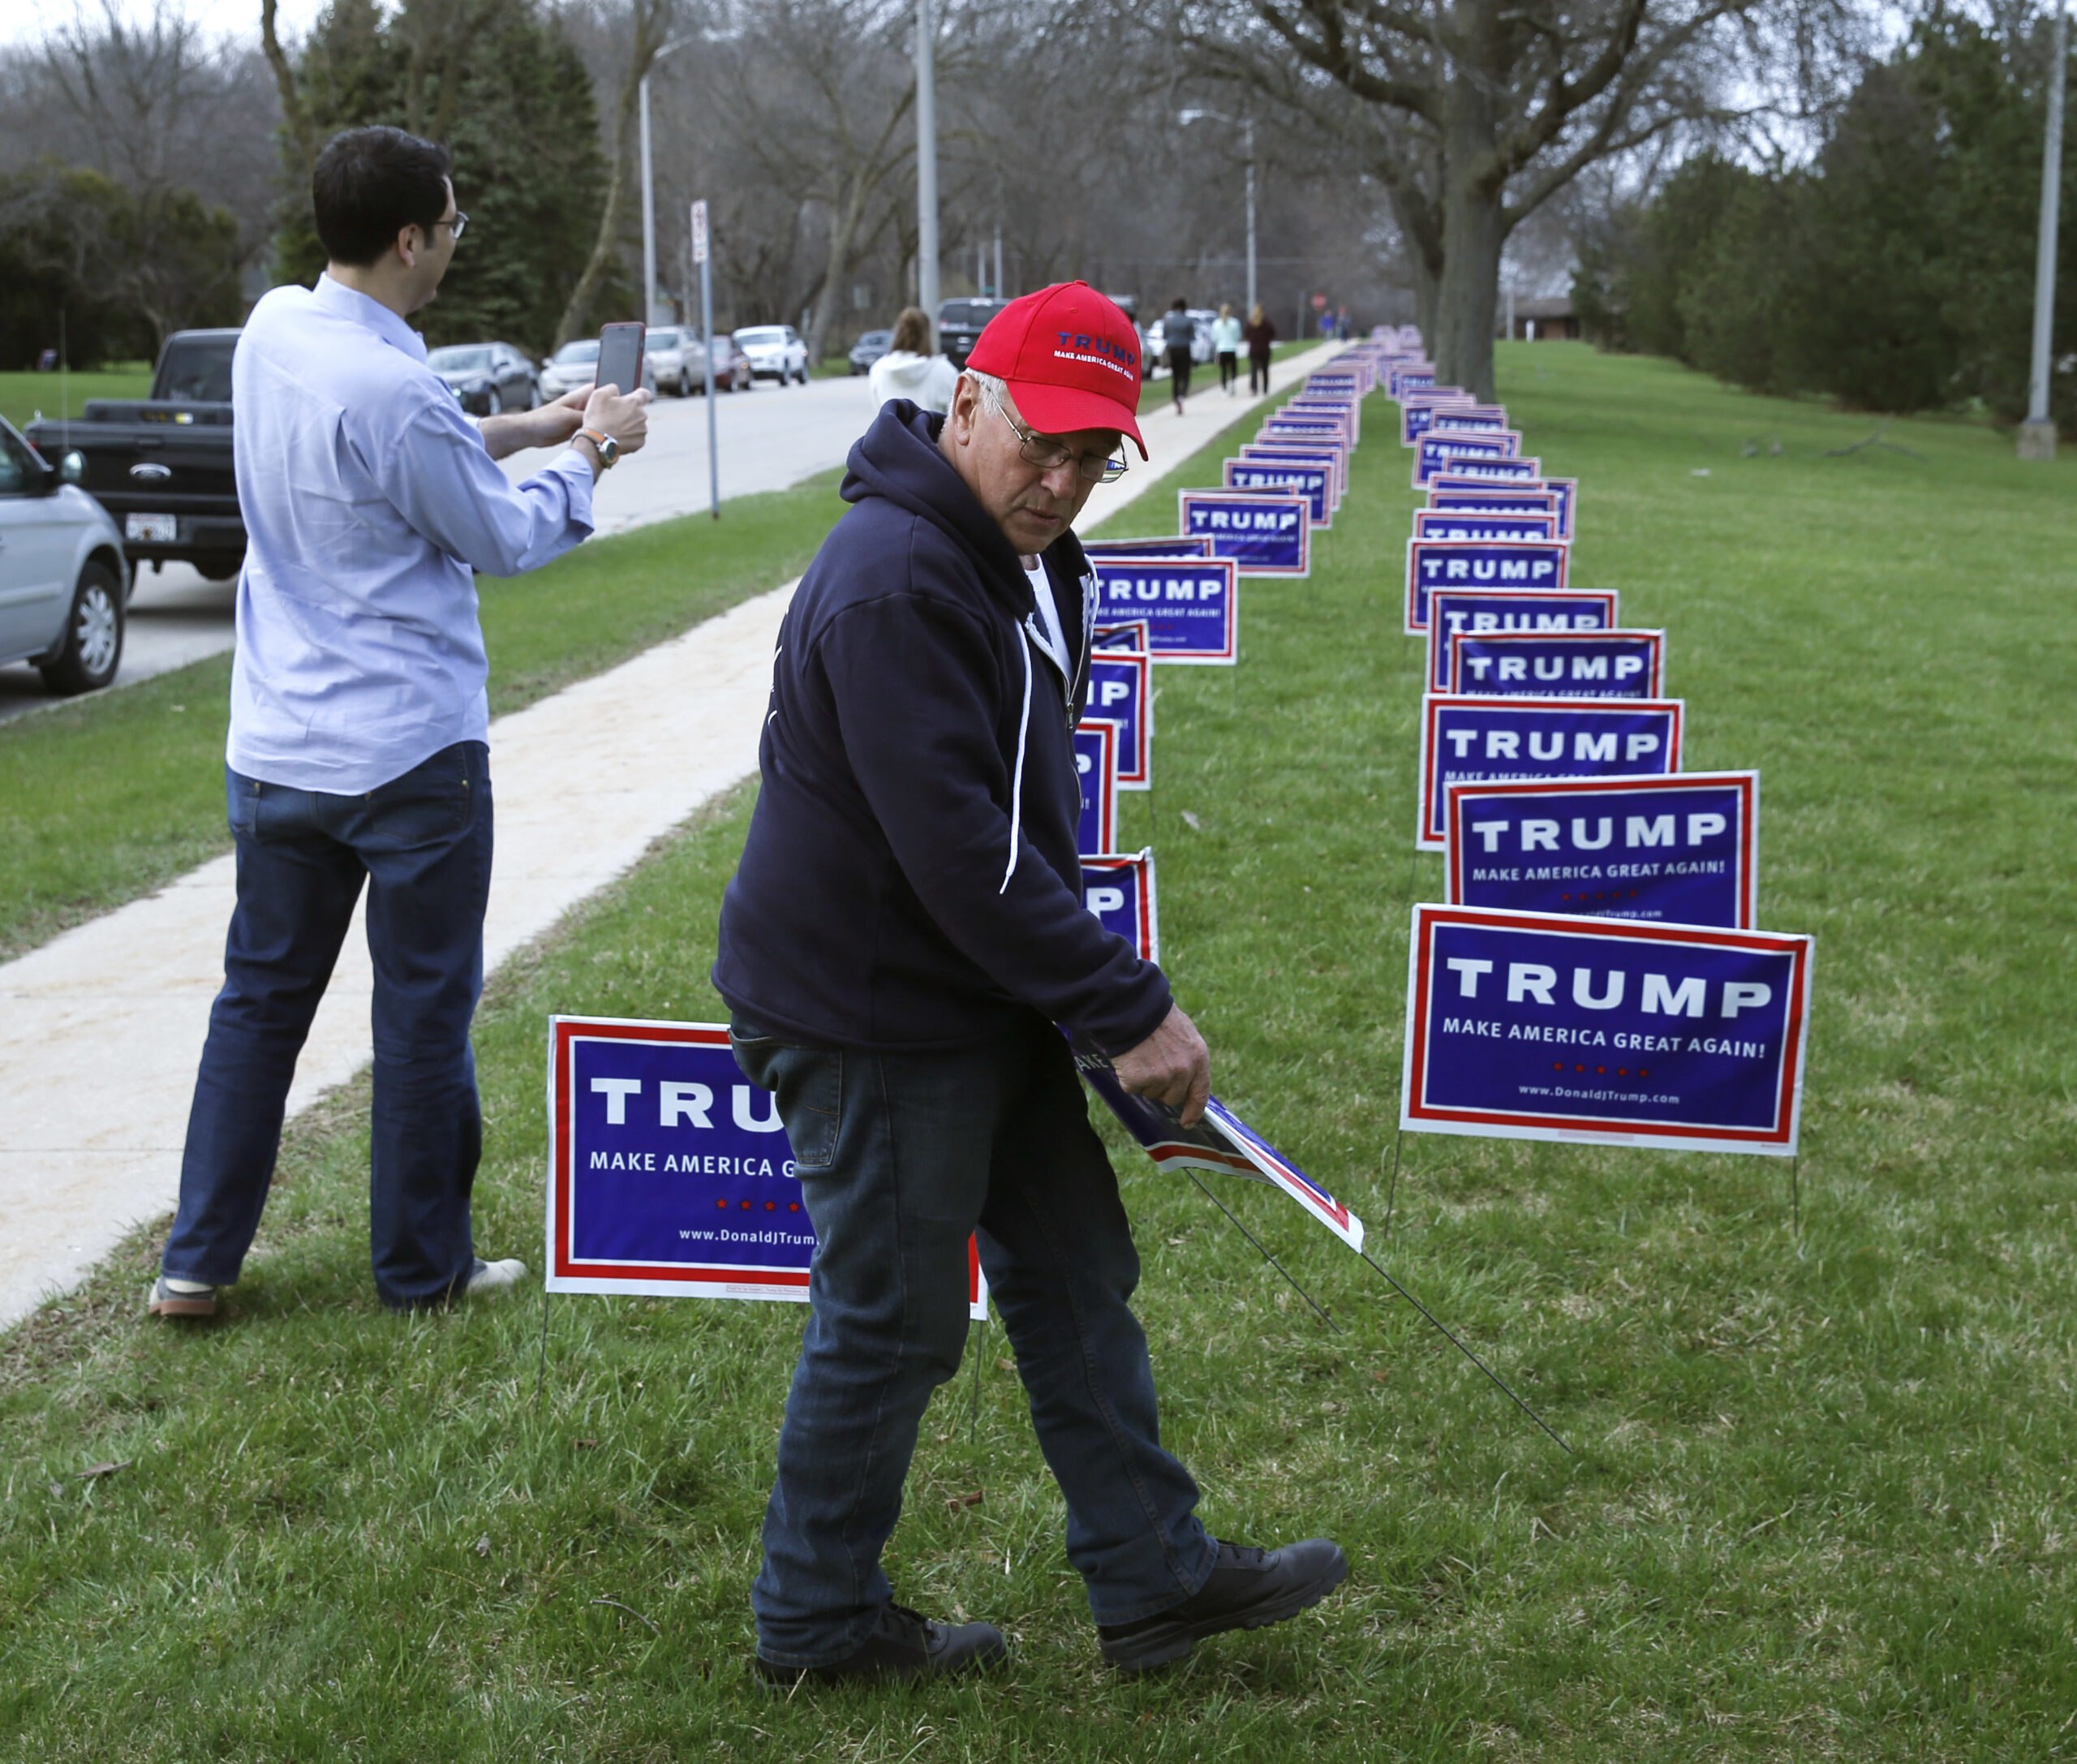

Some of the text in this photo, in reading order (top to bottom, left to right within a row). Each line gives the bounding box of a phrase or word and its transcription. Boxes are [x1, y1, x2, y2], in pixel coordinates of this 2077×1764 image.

[1056, 331, 1135, 366] TRUMP
[1054, 350, 1075, 359] MAKE
[1075, 353, 1107, 366] AMERICA
[1107, 361, 1123, 373] GREAT
[1233, 473, 1324, 490] TRUMP
[1190, 510, 1297, 530] TRUMP
[1422, 559, 1554, 579] TRUMP
[1098, 579, 1222, 600] RUMP
[1444, 612, 1600, 632] TRUMP
[1466, 656, 1643, 680] TRUMP
[1446, 729, 1660, 761] TRUMP
[1472, 813, 1727, 852] TRUMP
[1473, 859, 1726, 881] MAKE AMERICA GREAT AGAIN!
[1447, 957, 1772, 1019] TRUMP
[1443, 1018, 1765, 1058] MAKE AMERICA GREAT AGAIN!
[1075, 1054, 1108, 1071] AKE
[1518, 1084, 1680, 1104] www.DonaldJTrump.com
[591, 1078, 785, 1133] TRU
[590, 1151, 656, 1171] MAKE
[664, 1155, 772, 1177] AMERICA
[679, 1229, 819, 1246] www.DonaldJTrum
